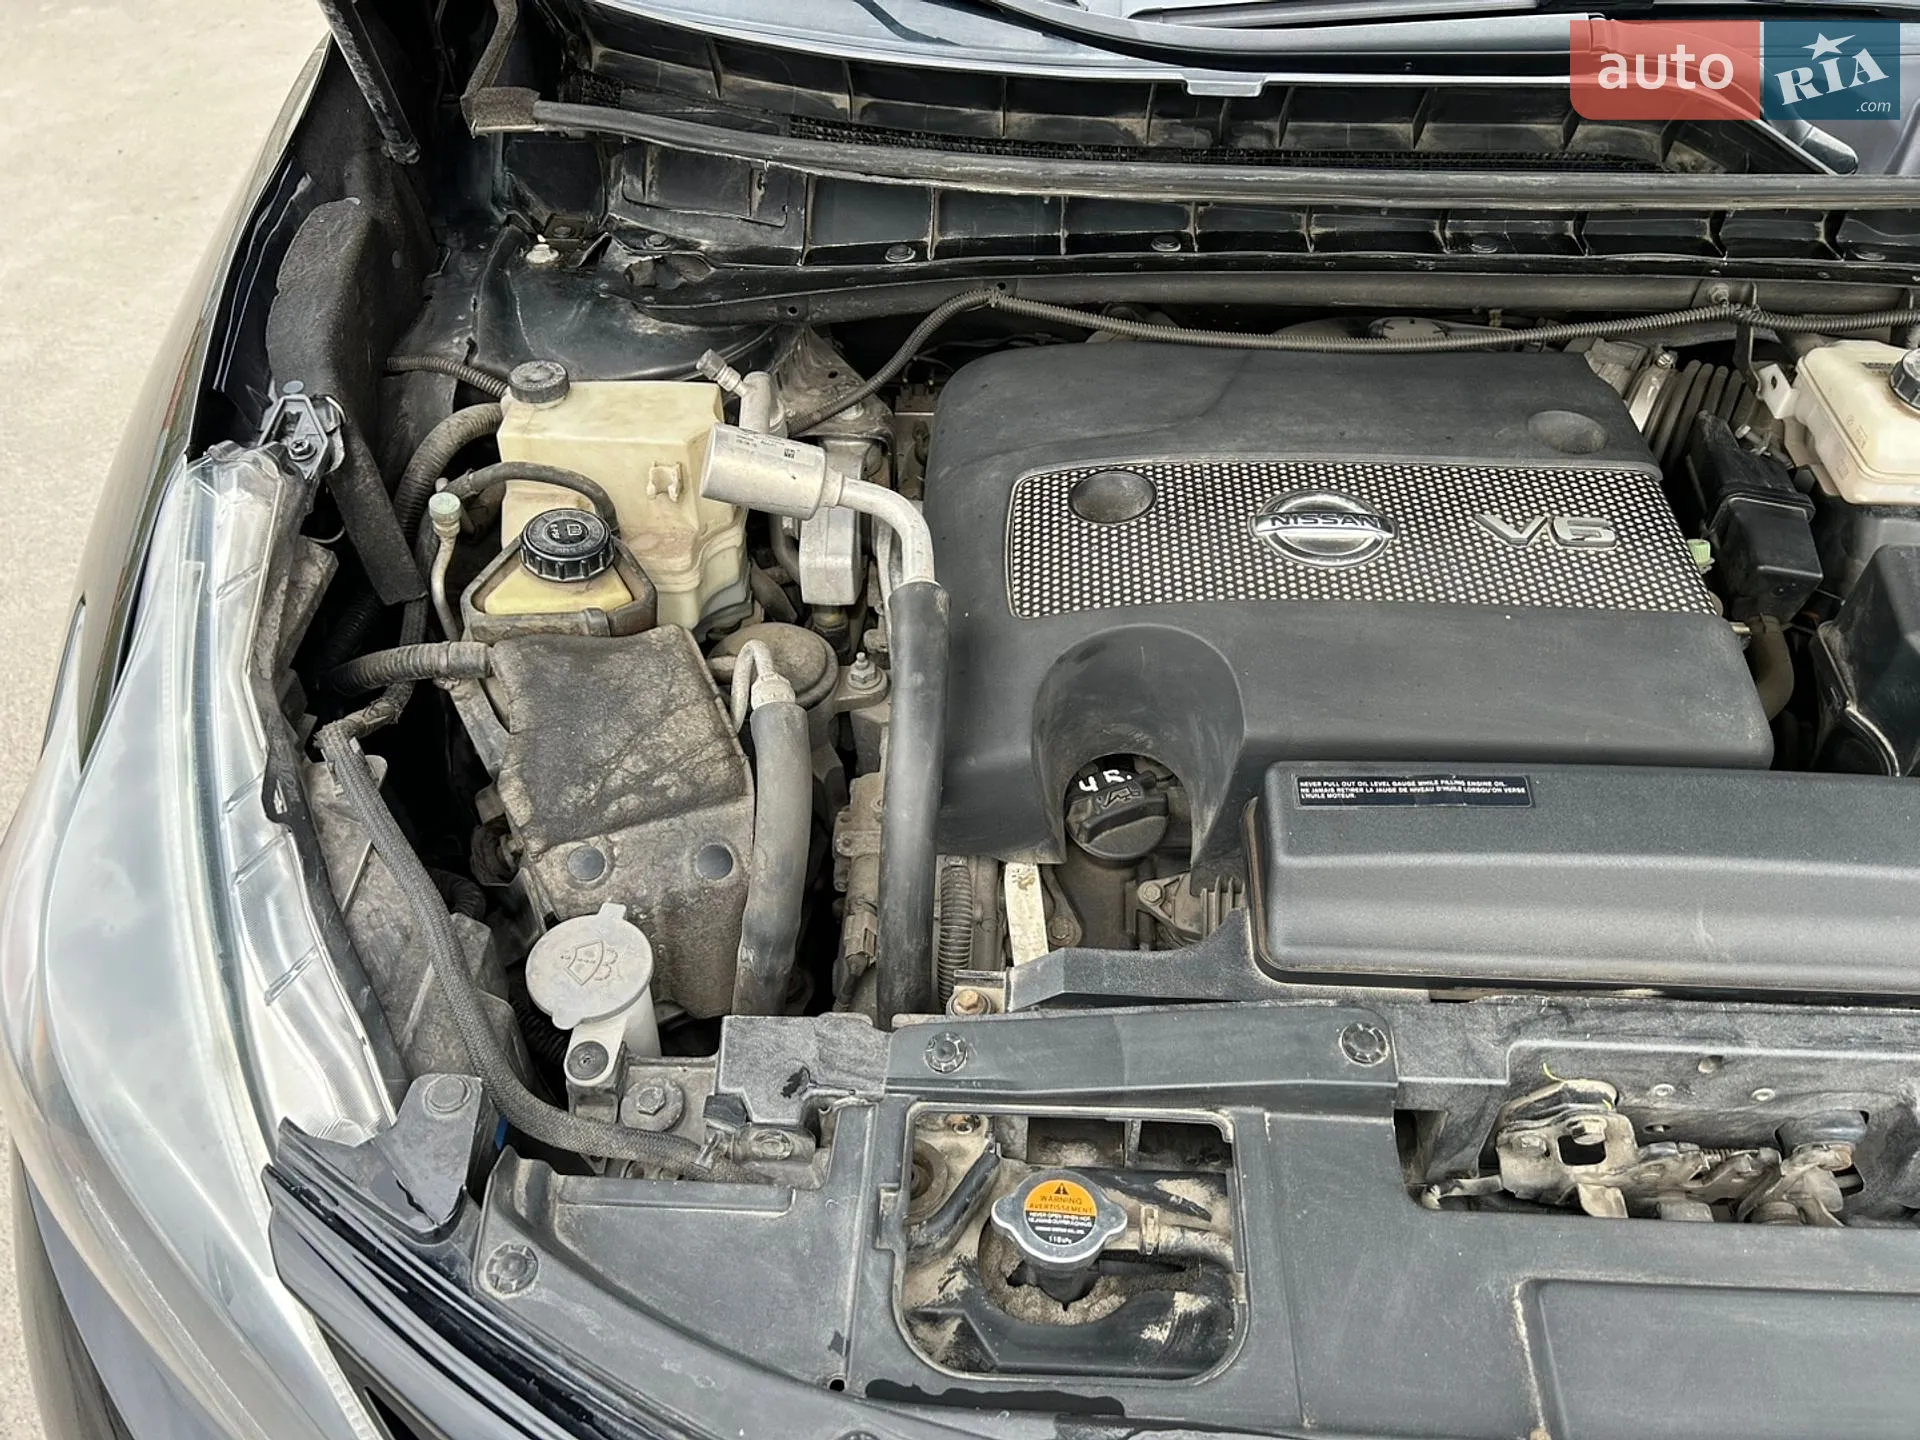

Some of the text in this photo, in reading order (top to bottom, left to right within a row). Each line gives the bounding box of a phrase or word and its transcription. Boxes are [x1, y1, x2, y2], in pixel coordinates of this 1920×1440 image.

[1270, 513, 1382, 530] NISSAN
[1473, 513, 1618, 547] V6
[1040, 1195, 1082, 1205] WARNING
[1029, 1203, 1092, 1213] AVERTISSEMENT
